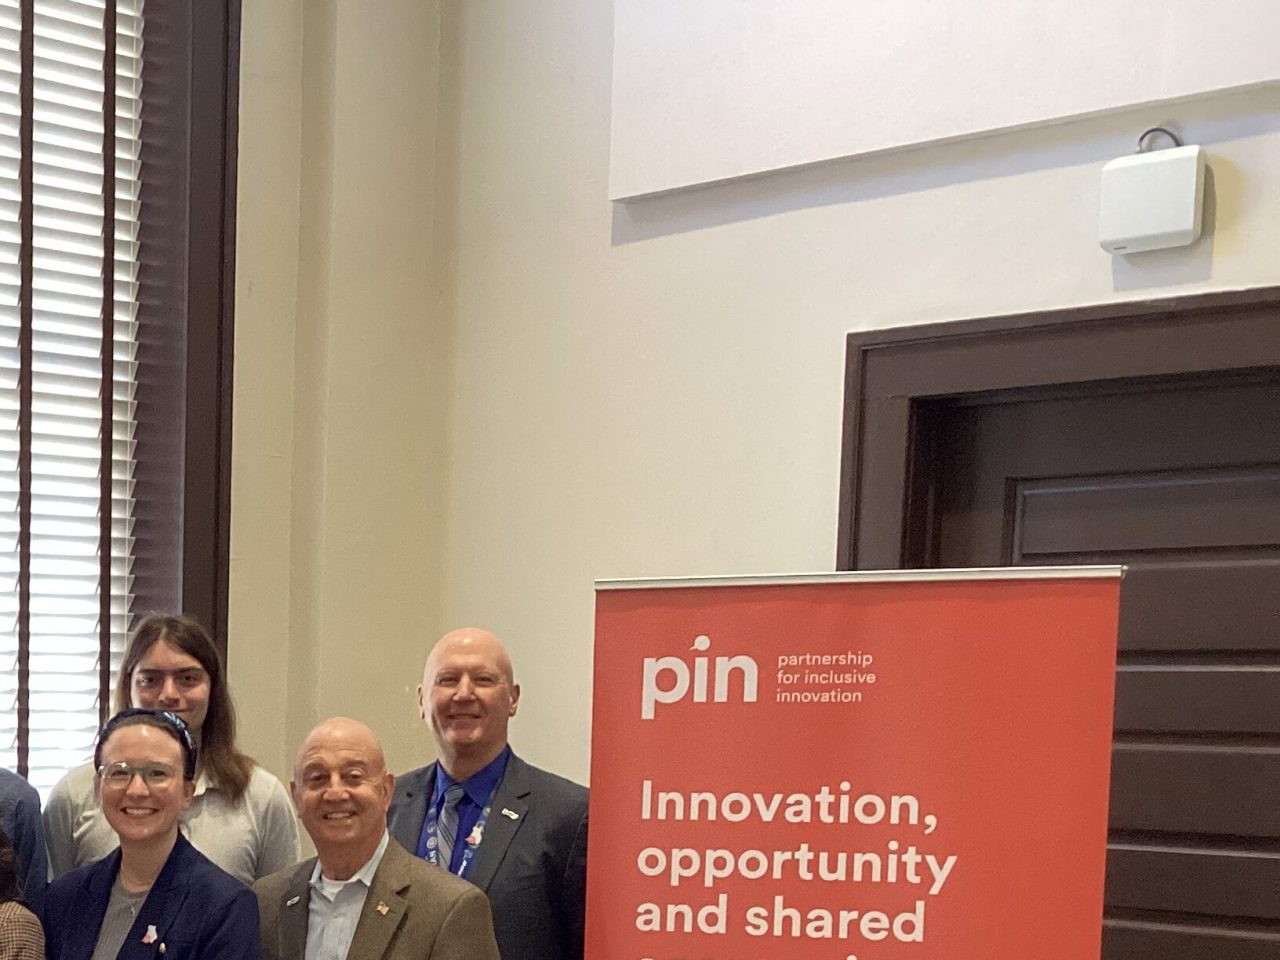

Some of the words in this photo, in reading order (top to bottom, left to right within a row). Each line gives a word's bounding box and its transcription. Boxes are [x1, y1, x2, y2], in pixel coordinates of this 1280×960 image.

[641, 635, 759, 720] pin
[777, 670, 800, 684] for
[805, 669, 876, 684] inclusive
[778, 651, 873, 668] partnership
[776, 688, 862, 702] innovation
[641, 780, 938, 835] Innovation,
[637, 840, 958, 895] opportunity
[635, 894, 728, 934] and
[744, 896, 926, 942] shared
